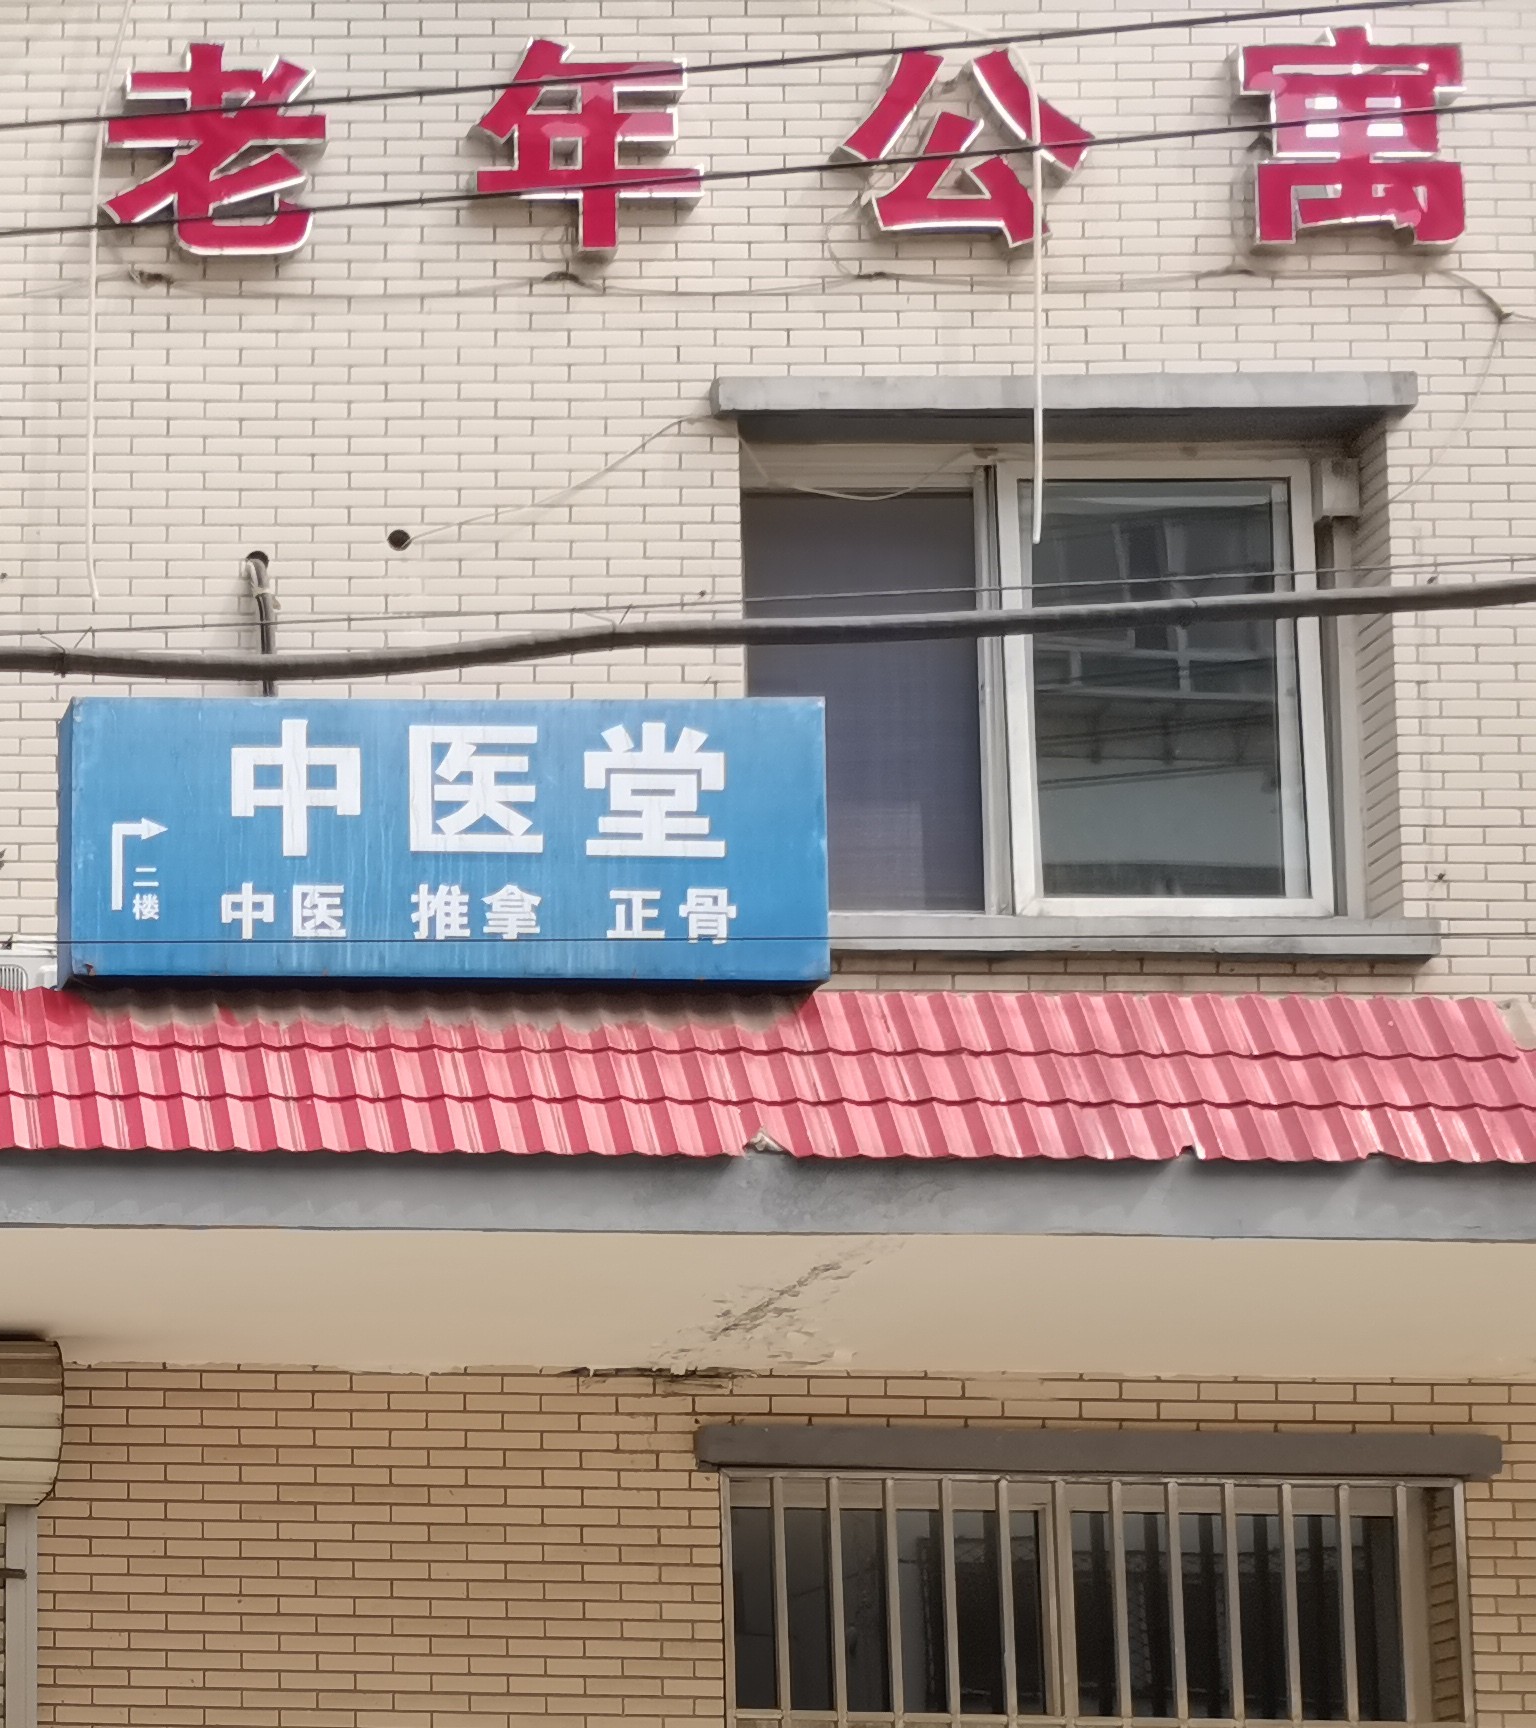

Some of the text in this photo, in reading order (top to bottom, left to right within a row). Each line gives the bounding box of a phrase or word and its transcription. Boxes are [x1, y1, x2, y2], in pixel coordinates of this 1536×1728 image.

[229, 718, 726, 858] 中医堂
[131, 866, 161, 922] 二楼
[220, 881, 738, 945] 中医 推拿 正骨
